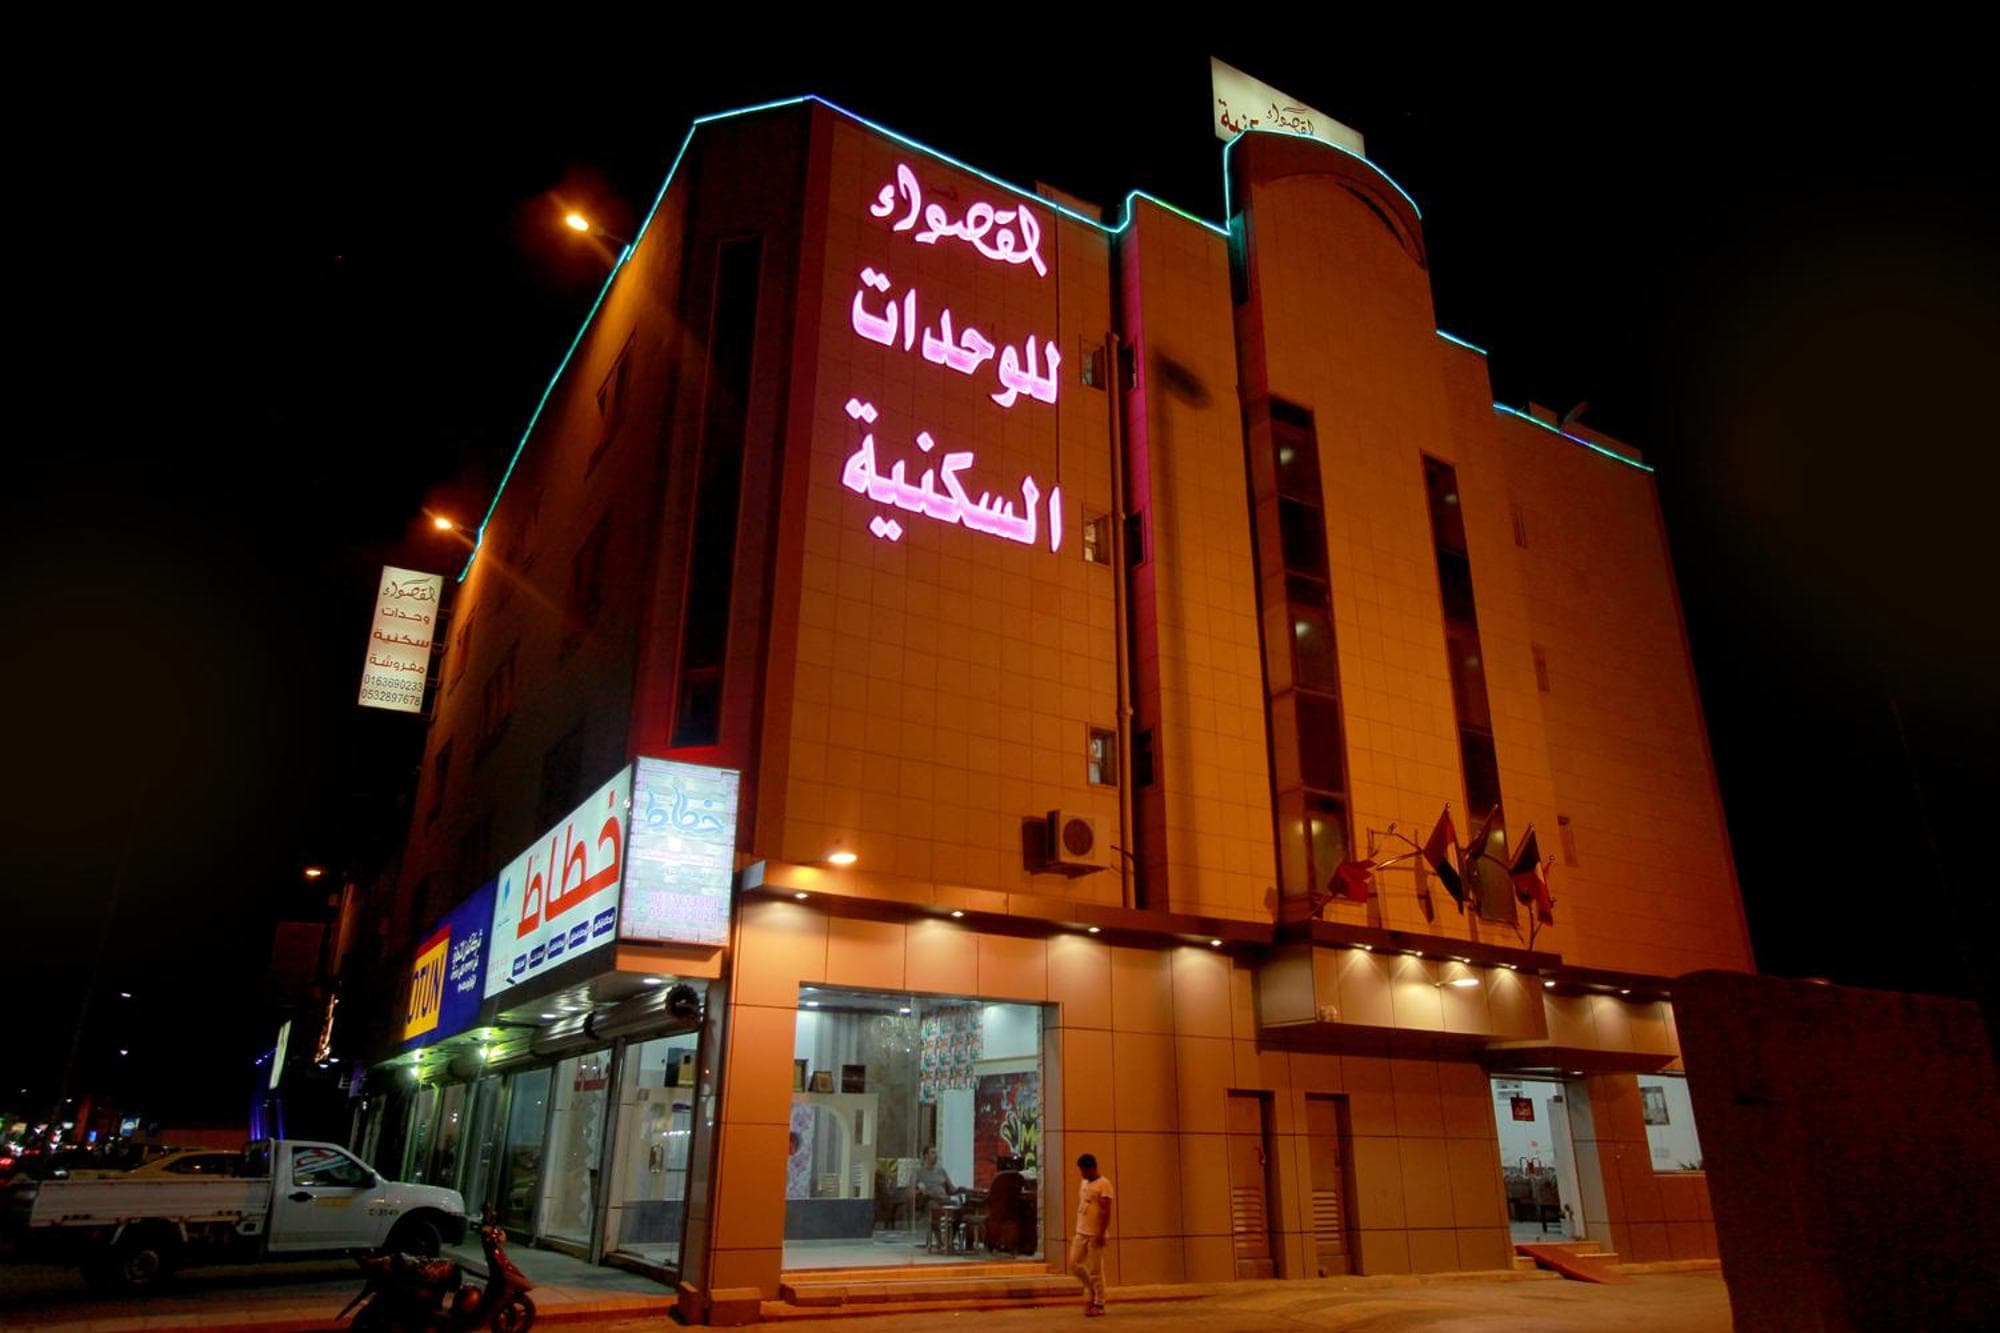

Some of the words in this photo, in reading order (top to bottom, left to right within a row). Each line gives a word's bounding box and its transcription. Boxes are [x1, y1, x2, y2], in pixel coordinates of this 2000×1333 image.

[870, 163, 1048, 277] القصواء
[851, 266, 1062, 409] للوحدات
[841, 397, 1062, 553] السكنية
[381, 607, 431, 625] وحدات
[383, 581, 436, 603] القصواء
[369, 653, 426, 674] مفروشة
[373, 628, 430, 650] سكنية
[517, 790, 623, 939] خطاط
